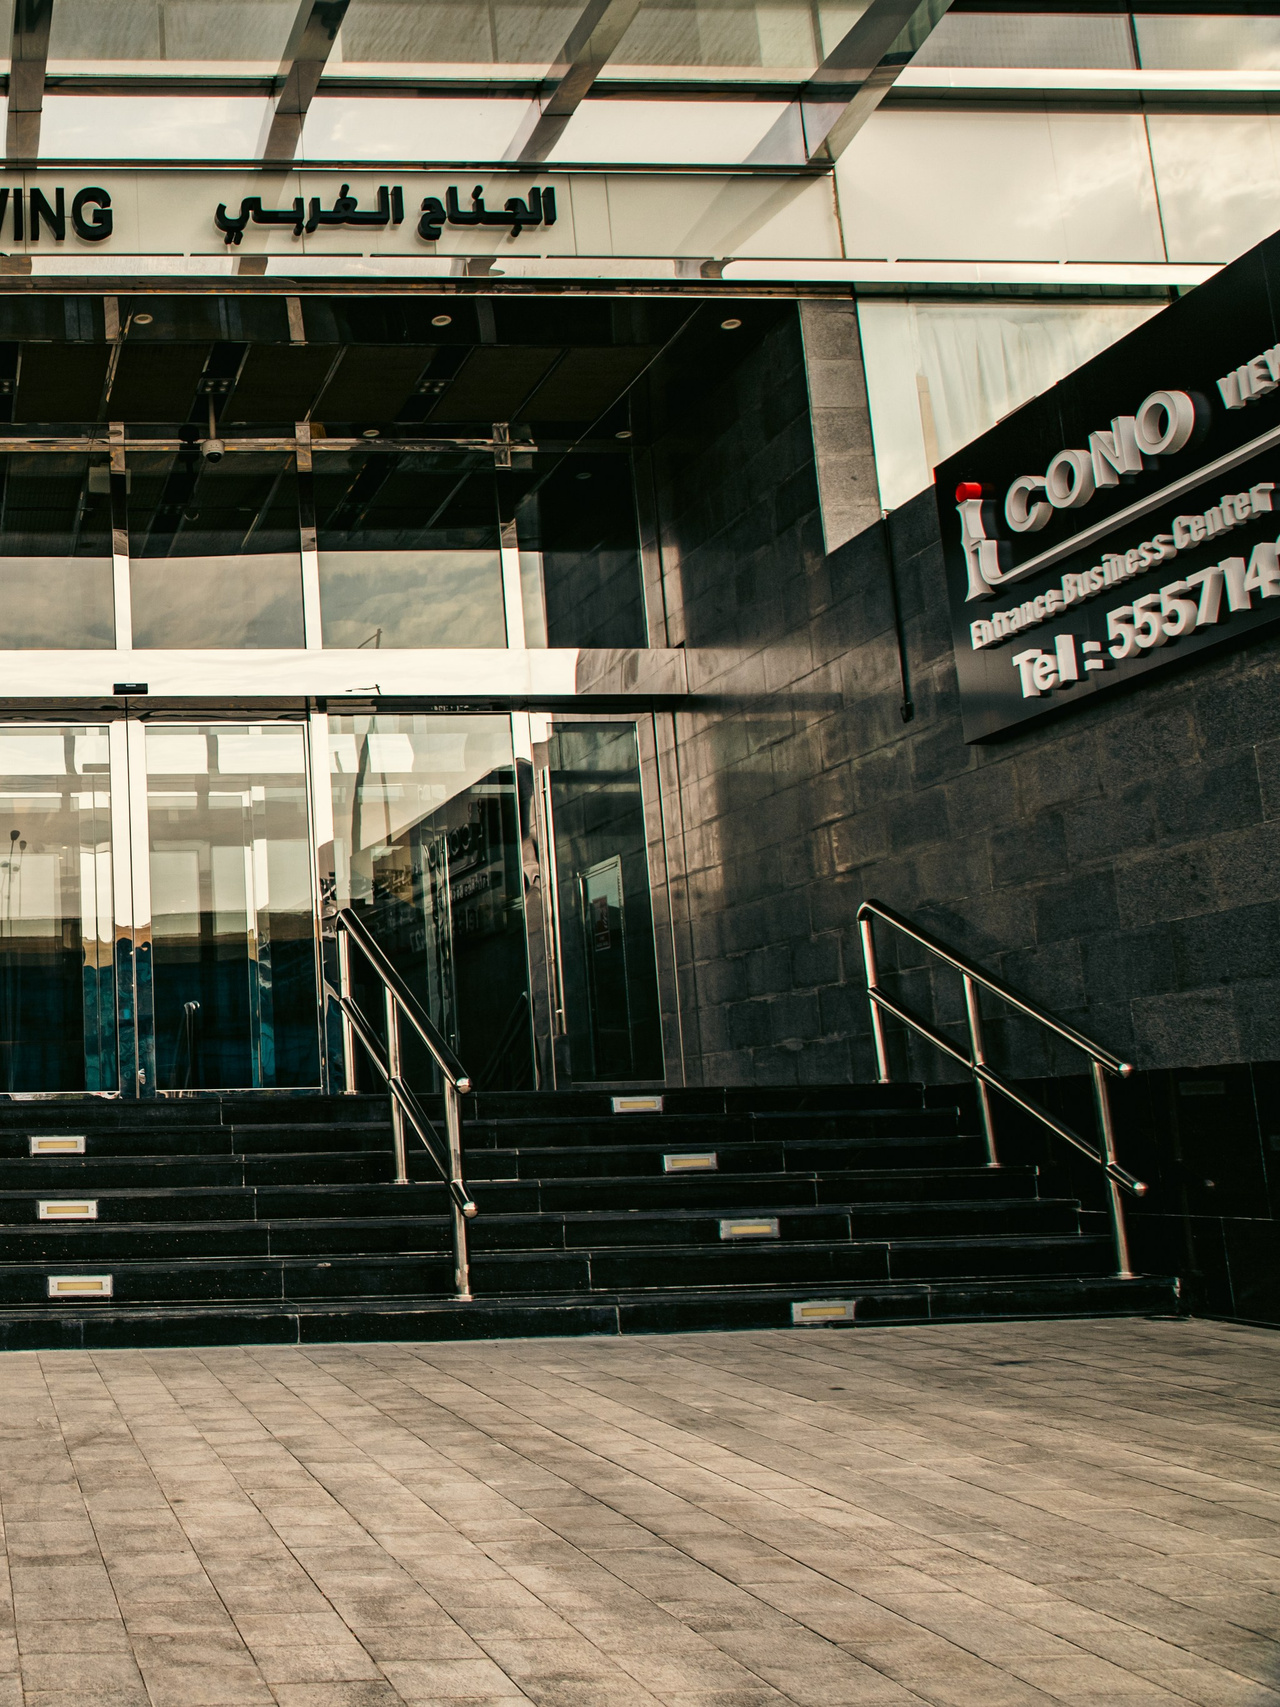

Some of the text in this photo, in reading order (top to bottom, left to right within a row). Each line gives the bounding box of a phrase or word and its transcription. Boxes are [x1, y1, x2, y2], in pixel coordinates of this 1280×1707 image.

[214, 183, 556, 245] الجناح الغربي
[970, 482, 1275, 650] Entrance Business Center
[1106, 533, 1280, 660] 555714
